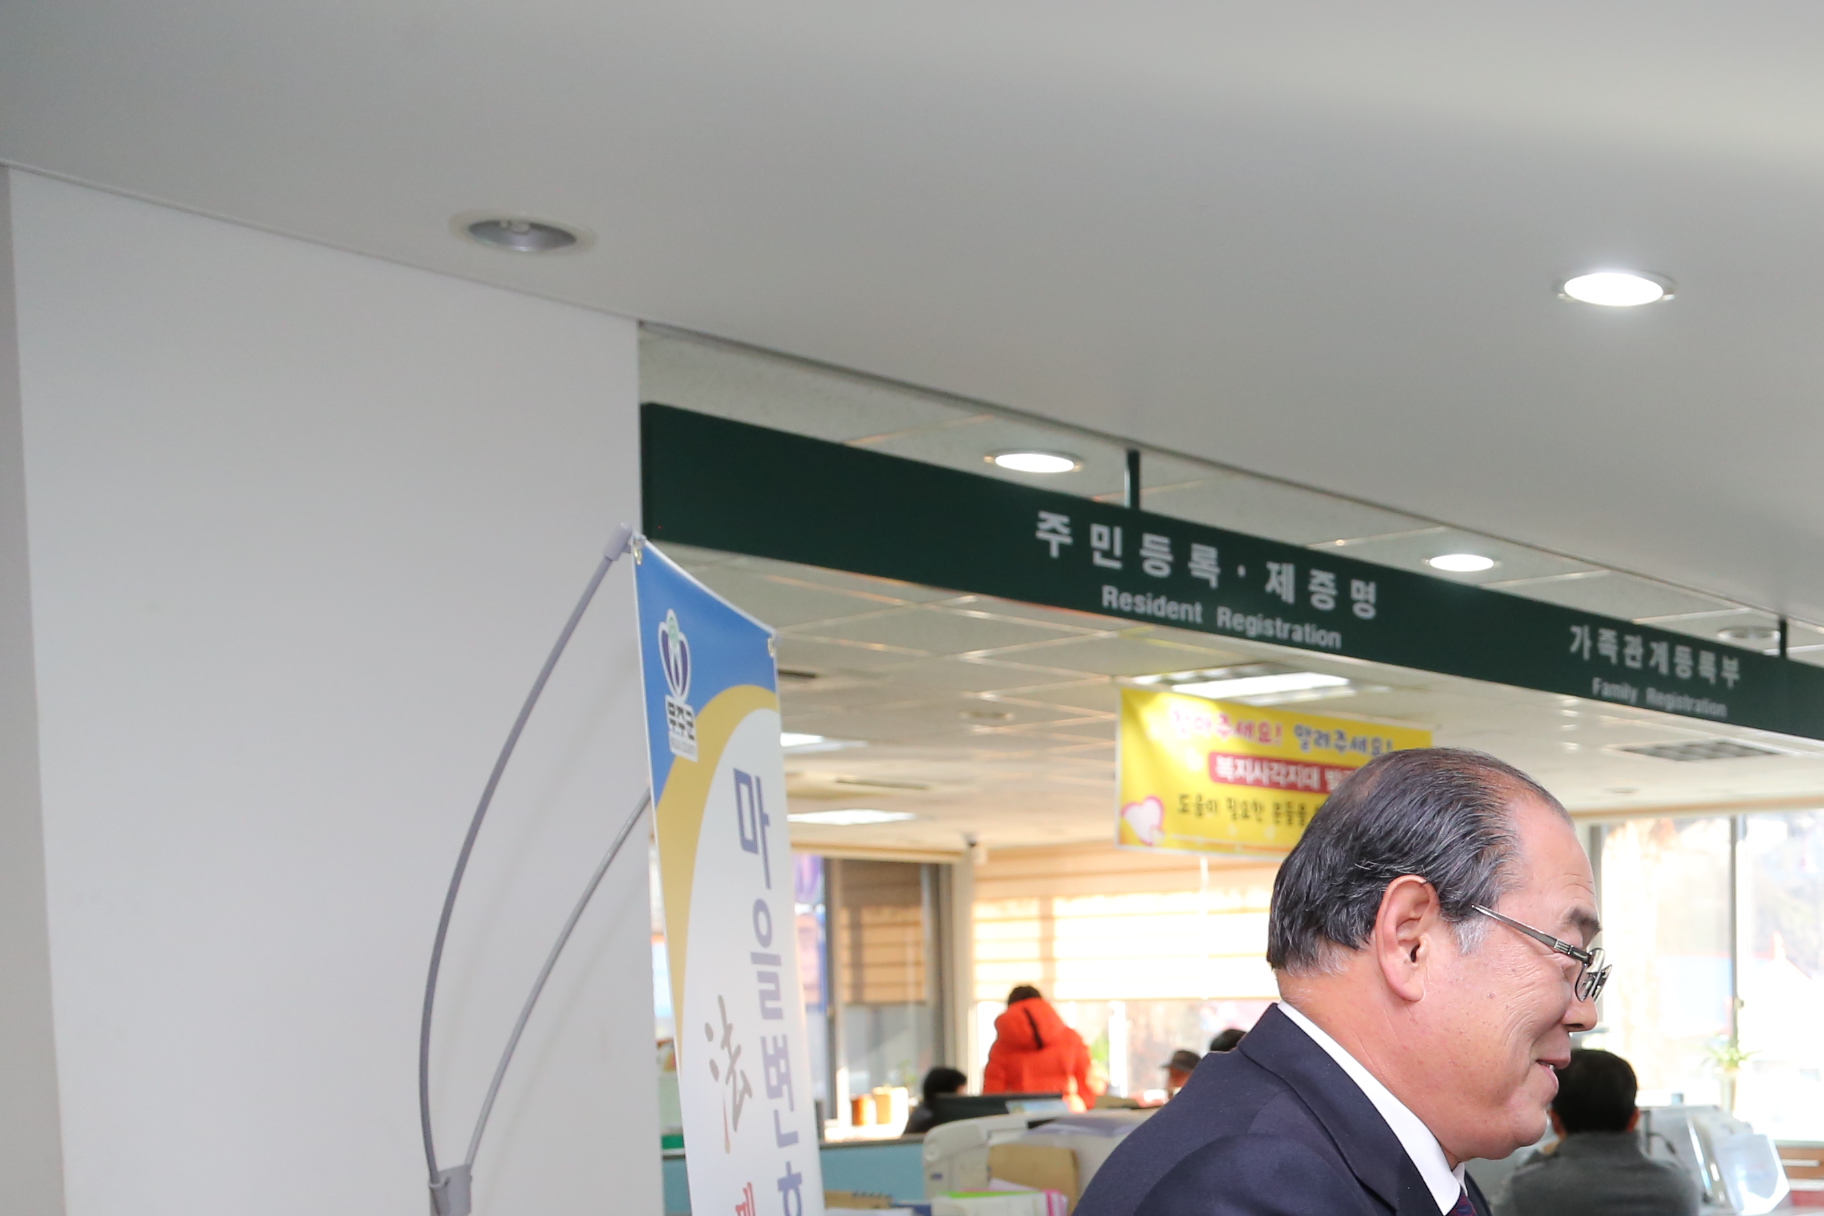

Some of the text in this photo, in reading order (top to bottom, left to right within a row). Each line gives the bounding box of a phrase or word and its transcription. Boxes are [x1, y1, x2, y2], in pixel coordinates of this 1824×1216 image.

[1101, 584, 1343, 650] Resident Registration
[1569, 624, 1741, 690] 가족관계등록부
[1591, 676, 1729, 719] Family Registration
